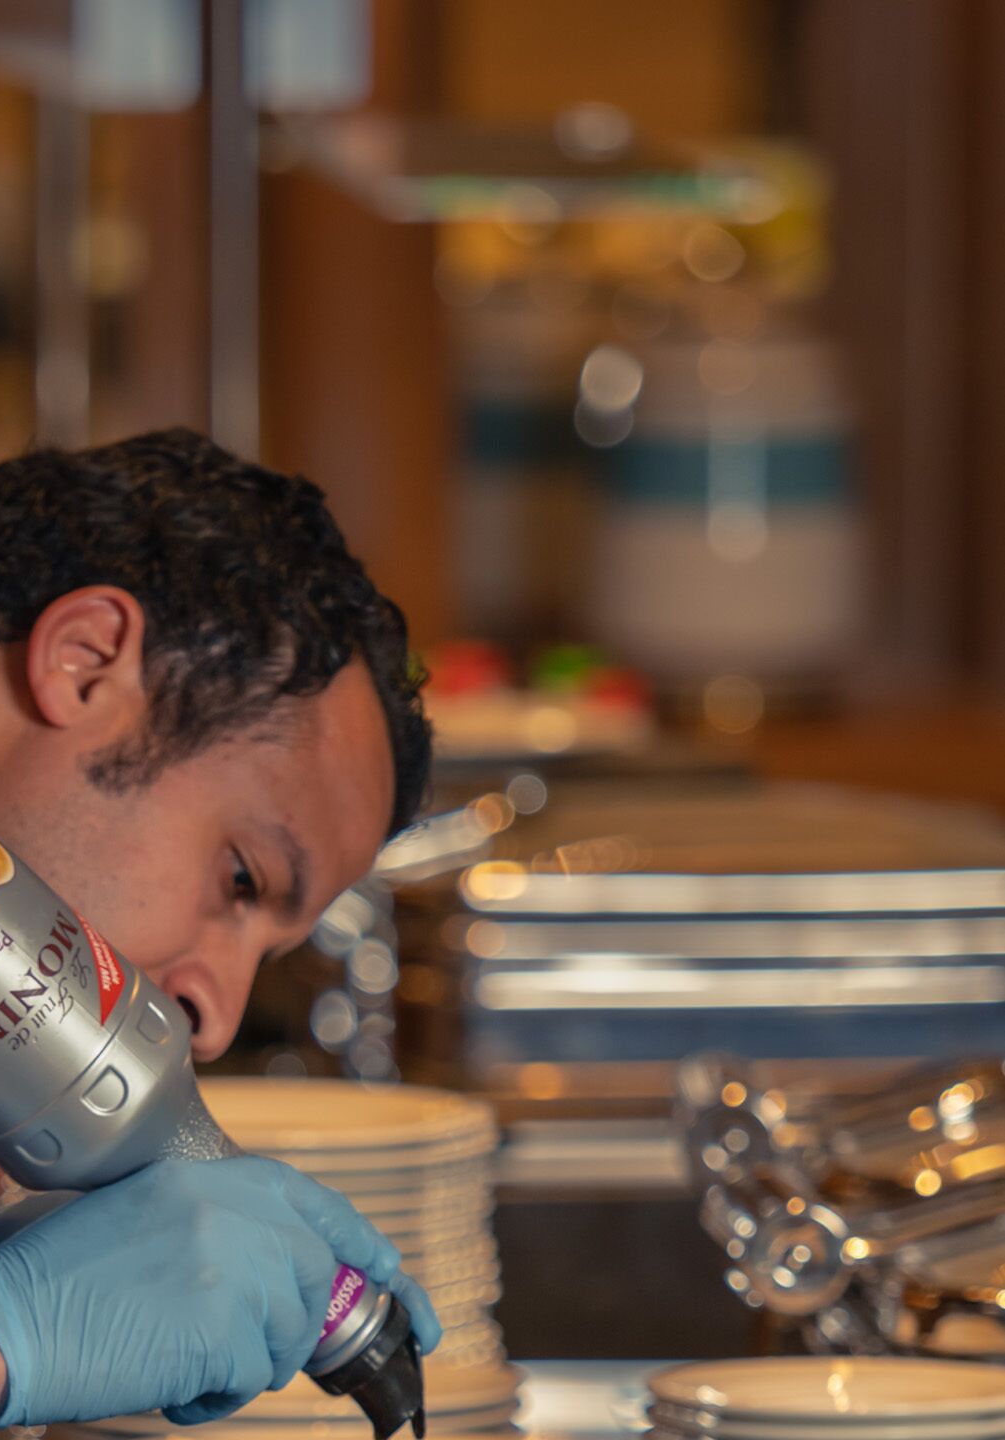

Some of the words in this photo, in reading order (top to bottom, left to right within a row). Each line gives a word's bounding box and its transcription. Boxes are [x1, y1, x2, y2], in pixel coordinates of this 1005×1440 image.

[69, 946, 92, 989] Le
[31, 976, 74, 1028] Fruit
[8, 1027, 31, 1051] de
[325, 1268, 363, 1321] Passion
